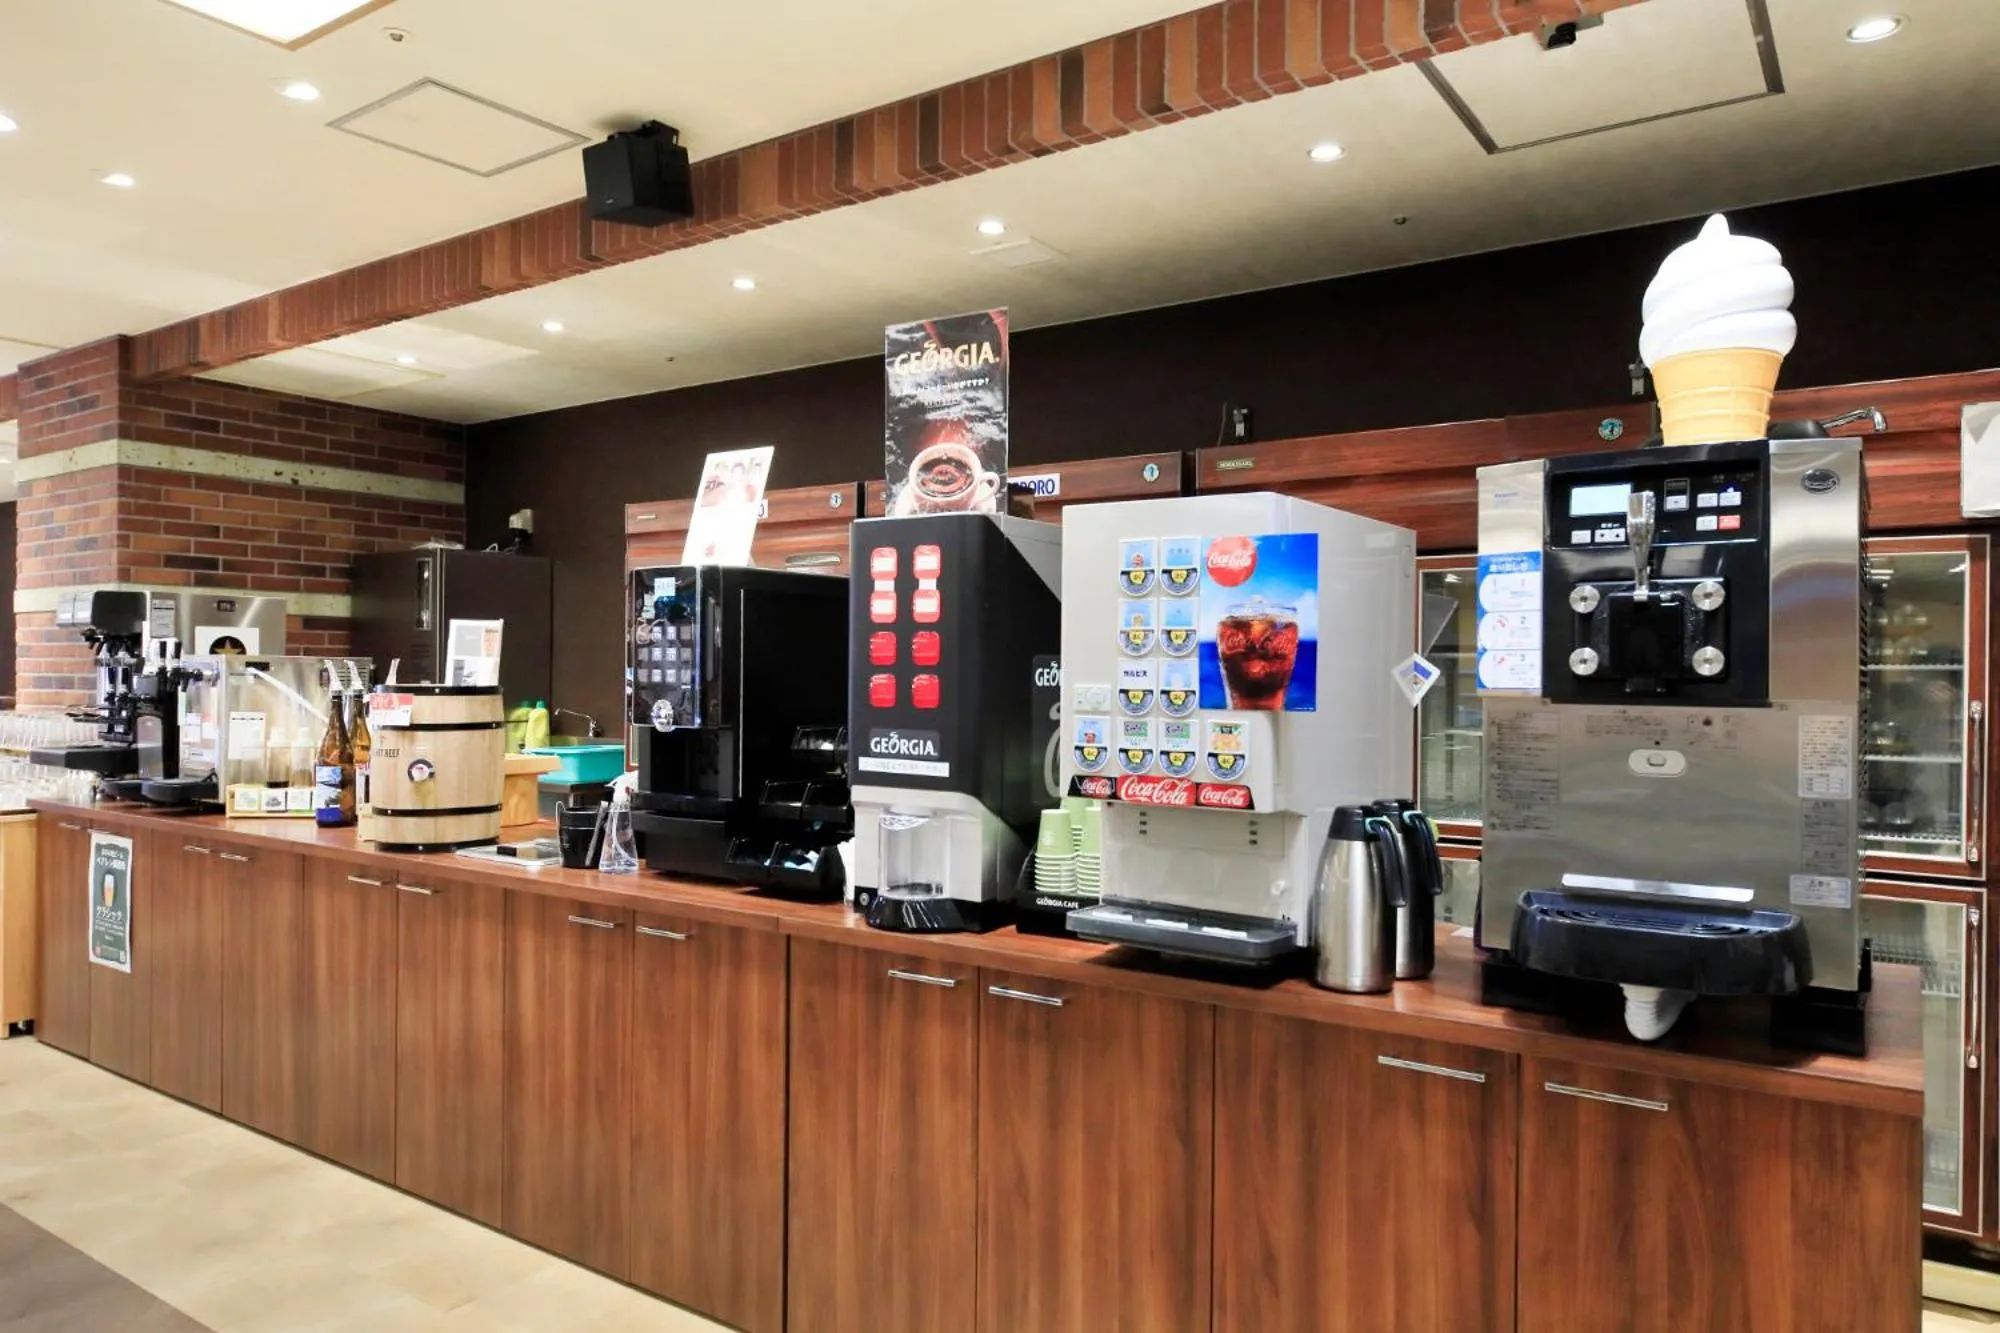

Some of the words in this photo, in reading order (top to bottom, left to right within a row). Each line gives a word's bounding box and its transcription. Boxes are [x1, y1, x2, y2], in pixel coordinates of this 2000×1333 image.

[894, 341, 996, 376] GEORGIA
[1208, 550, 1252, 569] Coca-Cola
[1035, 661, 1062, 687] GEO
[870, 731, 936, 755] GEORGIA
[1081, 778, 1112, 796] Coca-Cola
[1120, 775, 1193, 805] Coca-Cola
[1200, 786, 1249, 806] Coca-Cola
